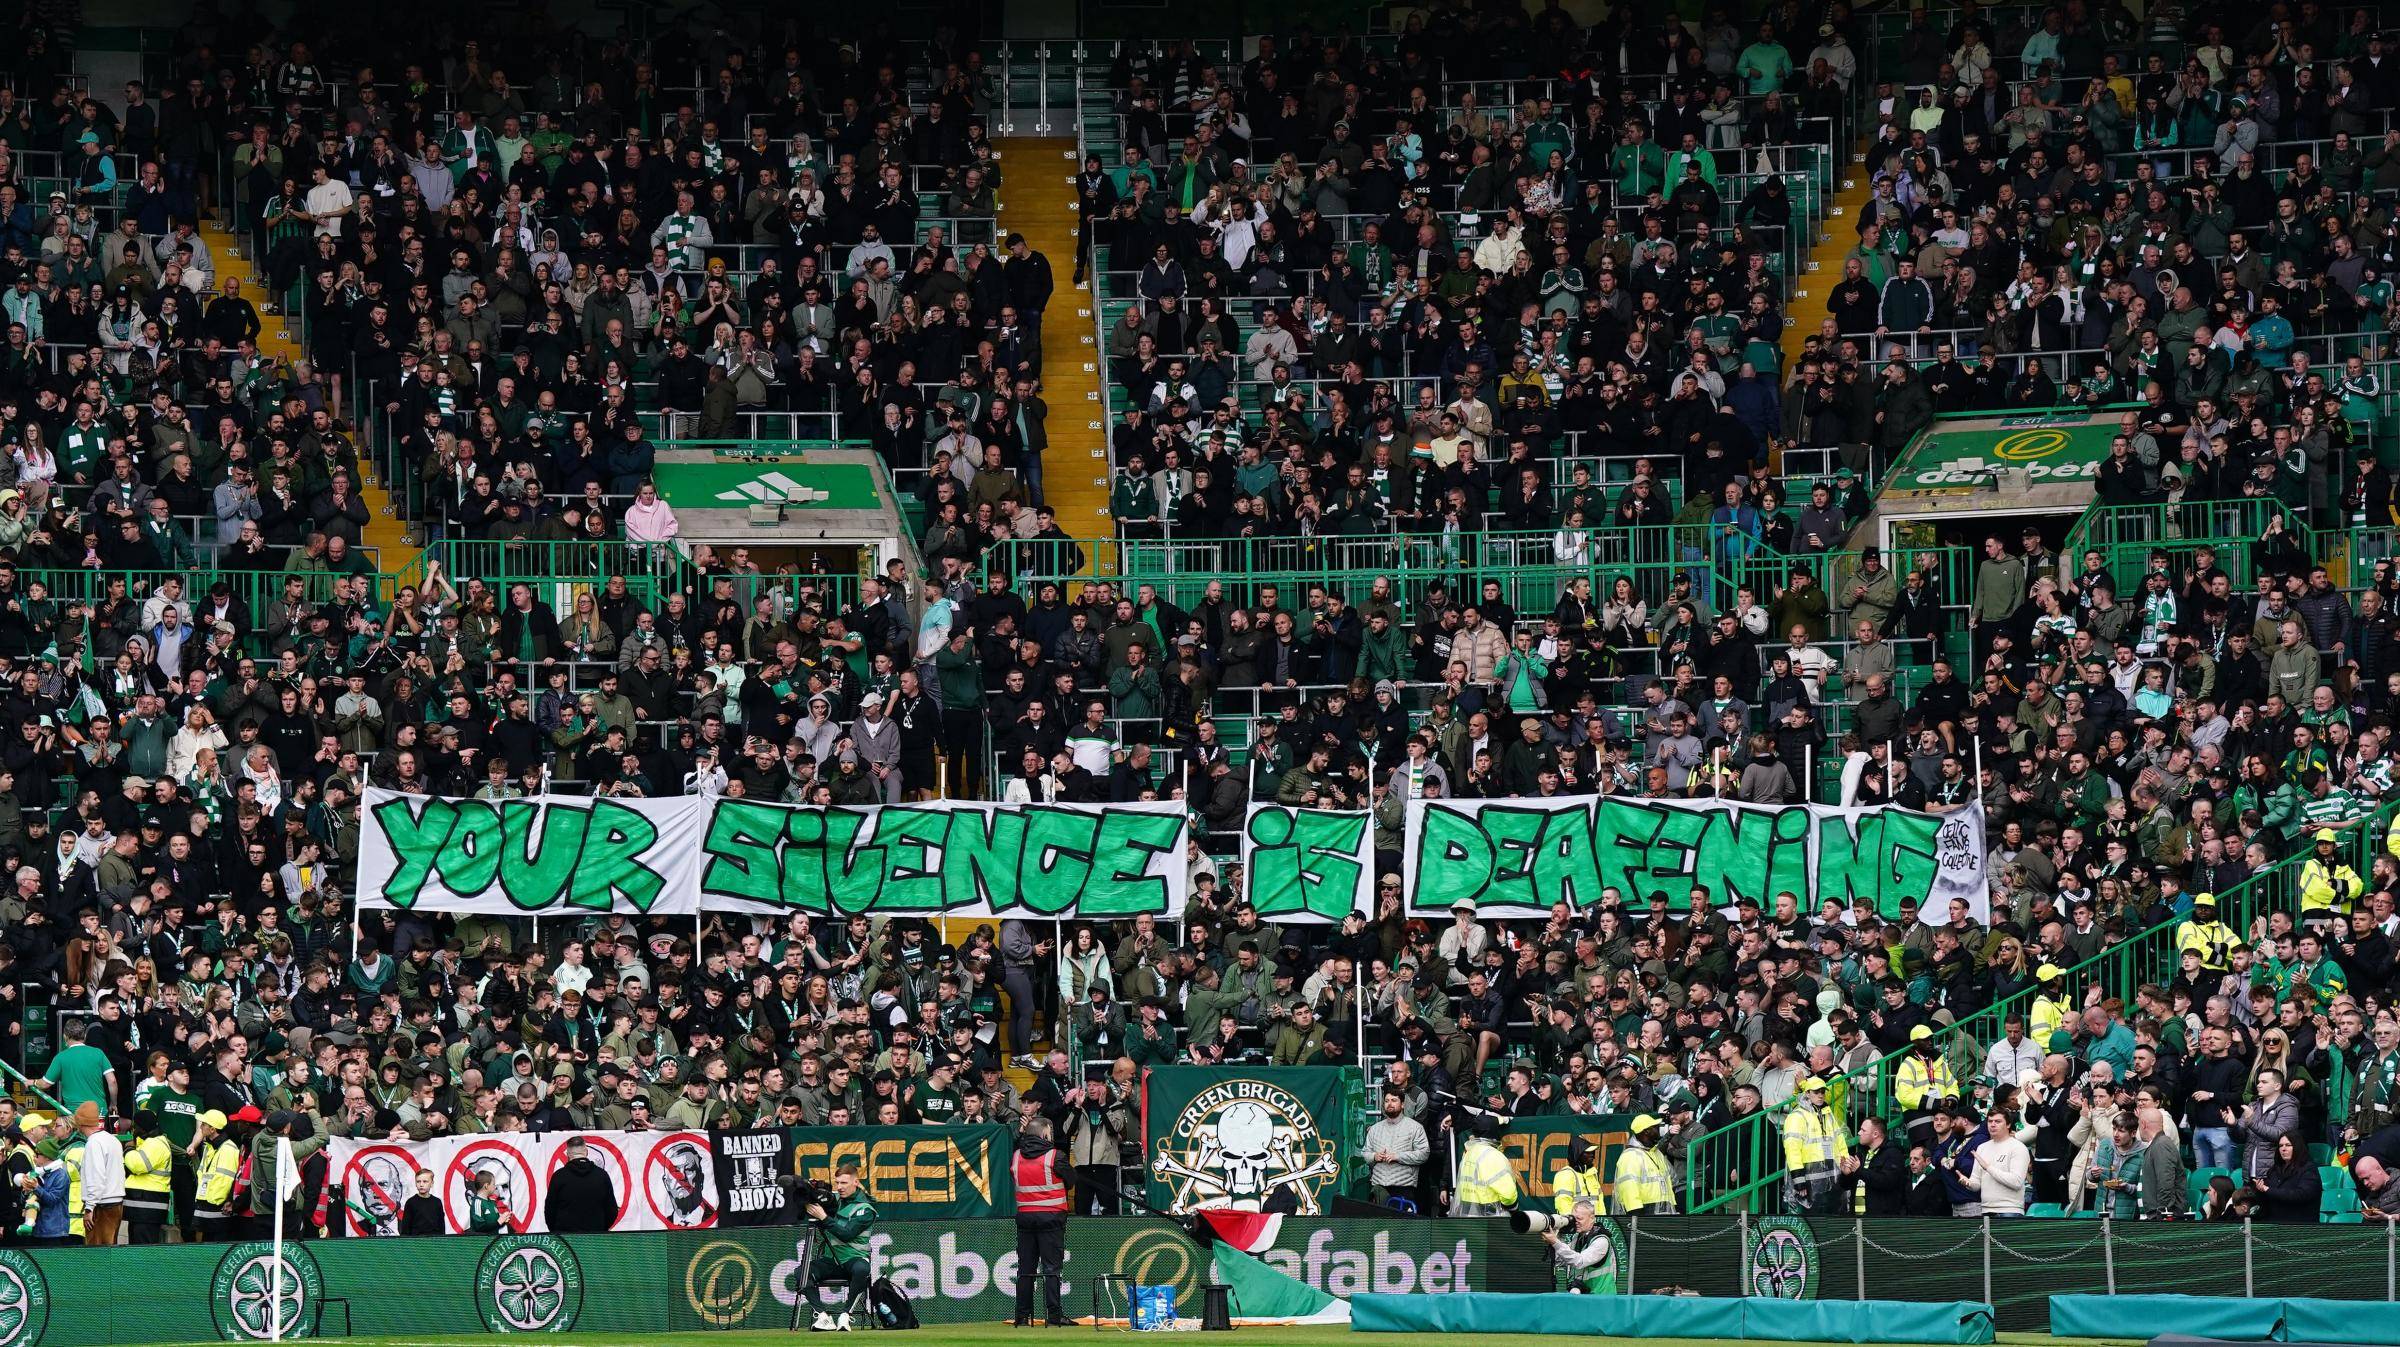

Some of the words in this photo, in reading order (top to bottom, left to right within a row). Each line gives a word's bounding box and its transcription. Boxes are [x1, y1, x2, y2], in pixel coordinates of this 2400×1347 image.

[228, 248, 239, 256] NN
[244, 276, 256, 284] MM
[1784, 318, 1795, 326] KK
[278, 331, 289, 339] KK
[366, 477, 376, 485] EE
[1094, 478, 1106, 486] EE
[400, 536, 412, 544] CC
[372, 795, 666, 912] YOUR
[28, 1099, 34, 1107] H
[1177, 1083, 1234, 1138] GREEN
[1238, 1082, 1317, 1141] BRIGADE
[722, 1134, 781, 1155] BANNED
[795, 1136, 992, 1206] GREEN
[729, 1187, 785, 1212] BHOYS
[216, 1276, 229, 1300] THE
[224, 1244, 254, 1275] CELTIC
[255, 1242, 304, 1266] FOOBALL
[303, 1265, 318, 1297] CLUB
[481, 1267, 493, 1290] THE
[488, 1236, 516, 1267] CELTIC
[562, 1258, 578, 1288] CLUB
[1210, 1229, 1472, 1297] afabet
[26, 1274, 43, 1305] CLUB
